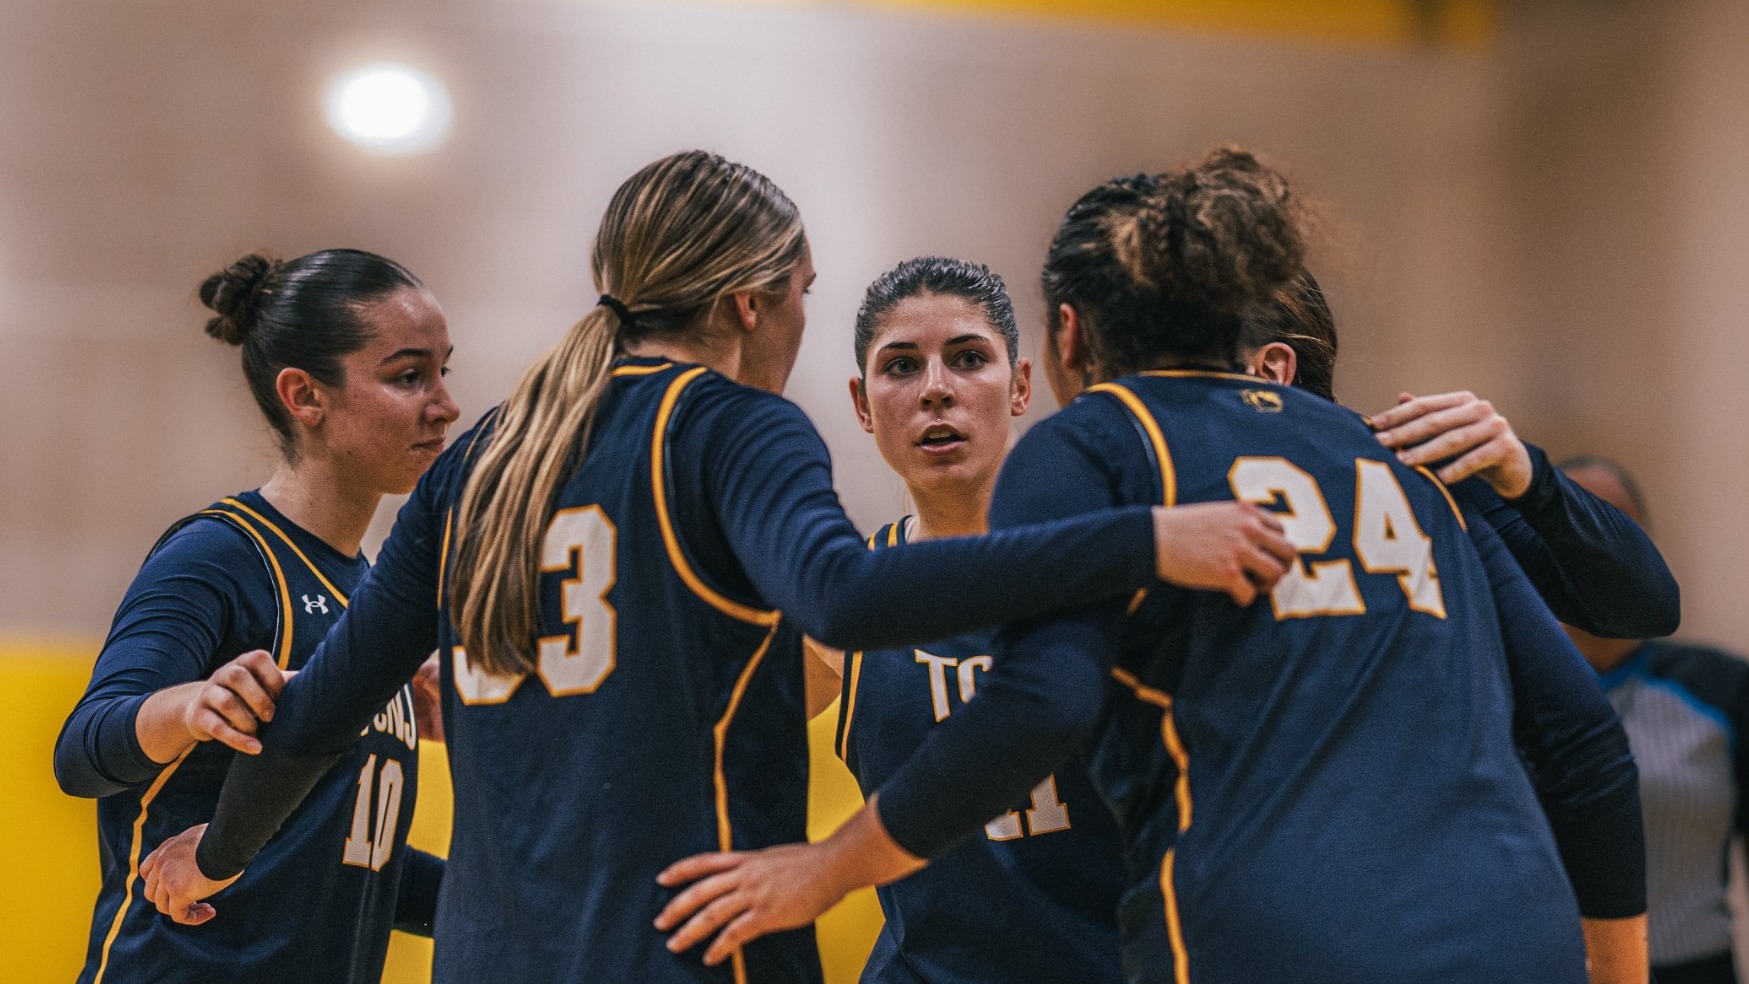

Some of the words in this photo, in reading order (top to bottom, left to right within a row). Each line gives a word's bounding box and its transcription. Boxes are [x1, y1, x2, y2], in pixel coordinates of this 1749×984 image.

[452, 503, 617, 706] 3
[1227, 455, 1447, 621] 24
[342, 753, 404, 873] 10
